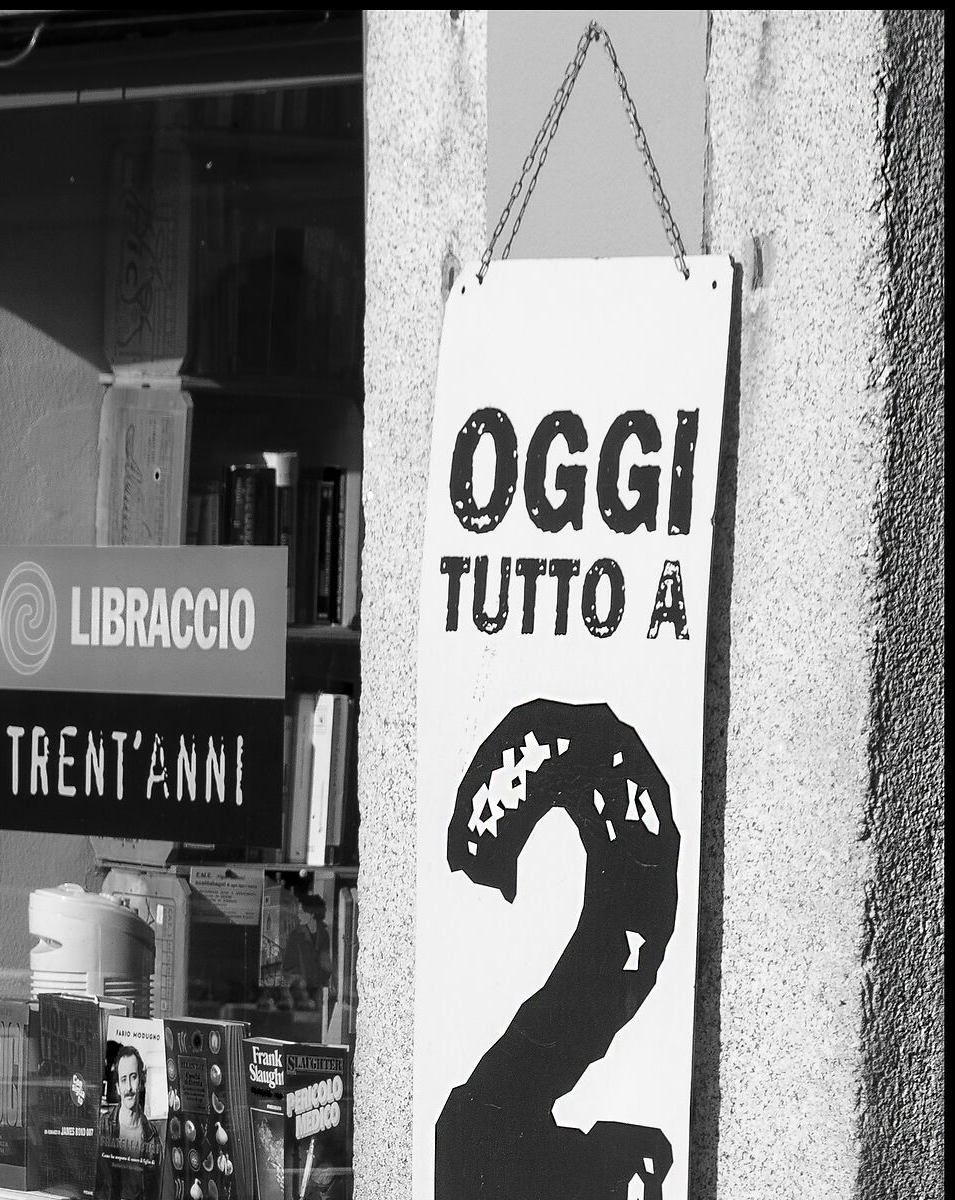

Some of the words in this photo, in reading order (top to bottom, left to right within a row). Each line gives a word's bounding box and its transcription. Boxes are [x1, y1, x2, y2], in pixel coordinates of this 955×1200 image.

[449, 408, 700, 535] OGGI
[71, 587, 255, 650] LIBRACCIO
[440, 556, 626, 639] TUTTO
[646, 560, 690, 640] A
[6, 725, 244, 805] TRENT'ANNI
[115, 1029, 131, 1038] FABIO
[132, 1031, 161, 1041] MODUGNO
[252, 1046, 283, 1068] Frank
[287, 1055, 344, 1073] SLAUGHTER
[286, 1075, 344, 1118] PERICOLO
[295, 1101, 341, 1140] MEDICO
